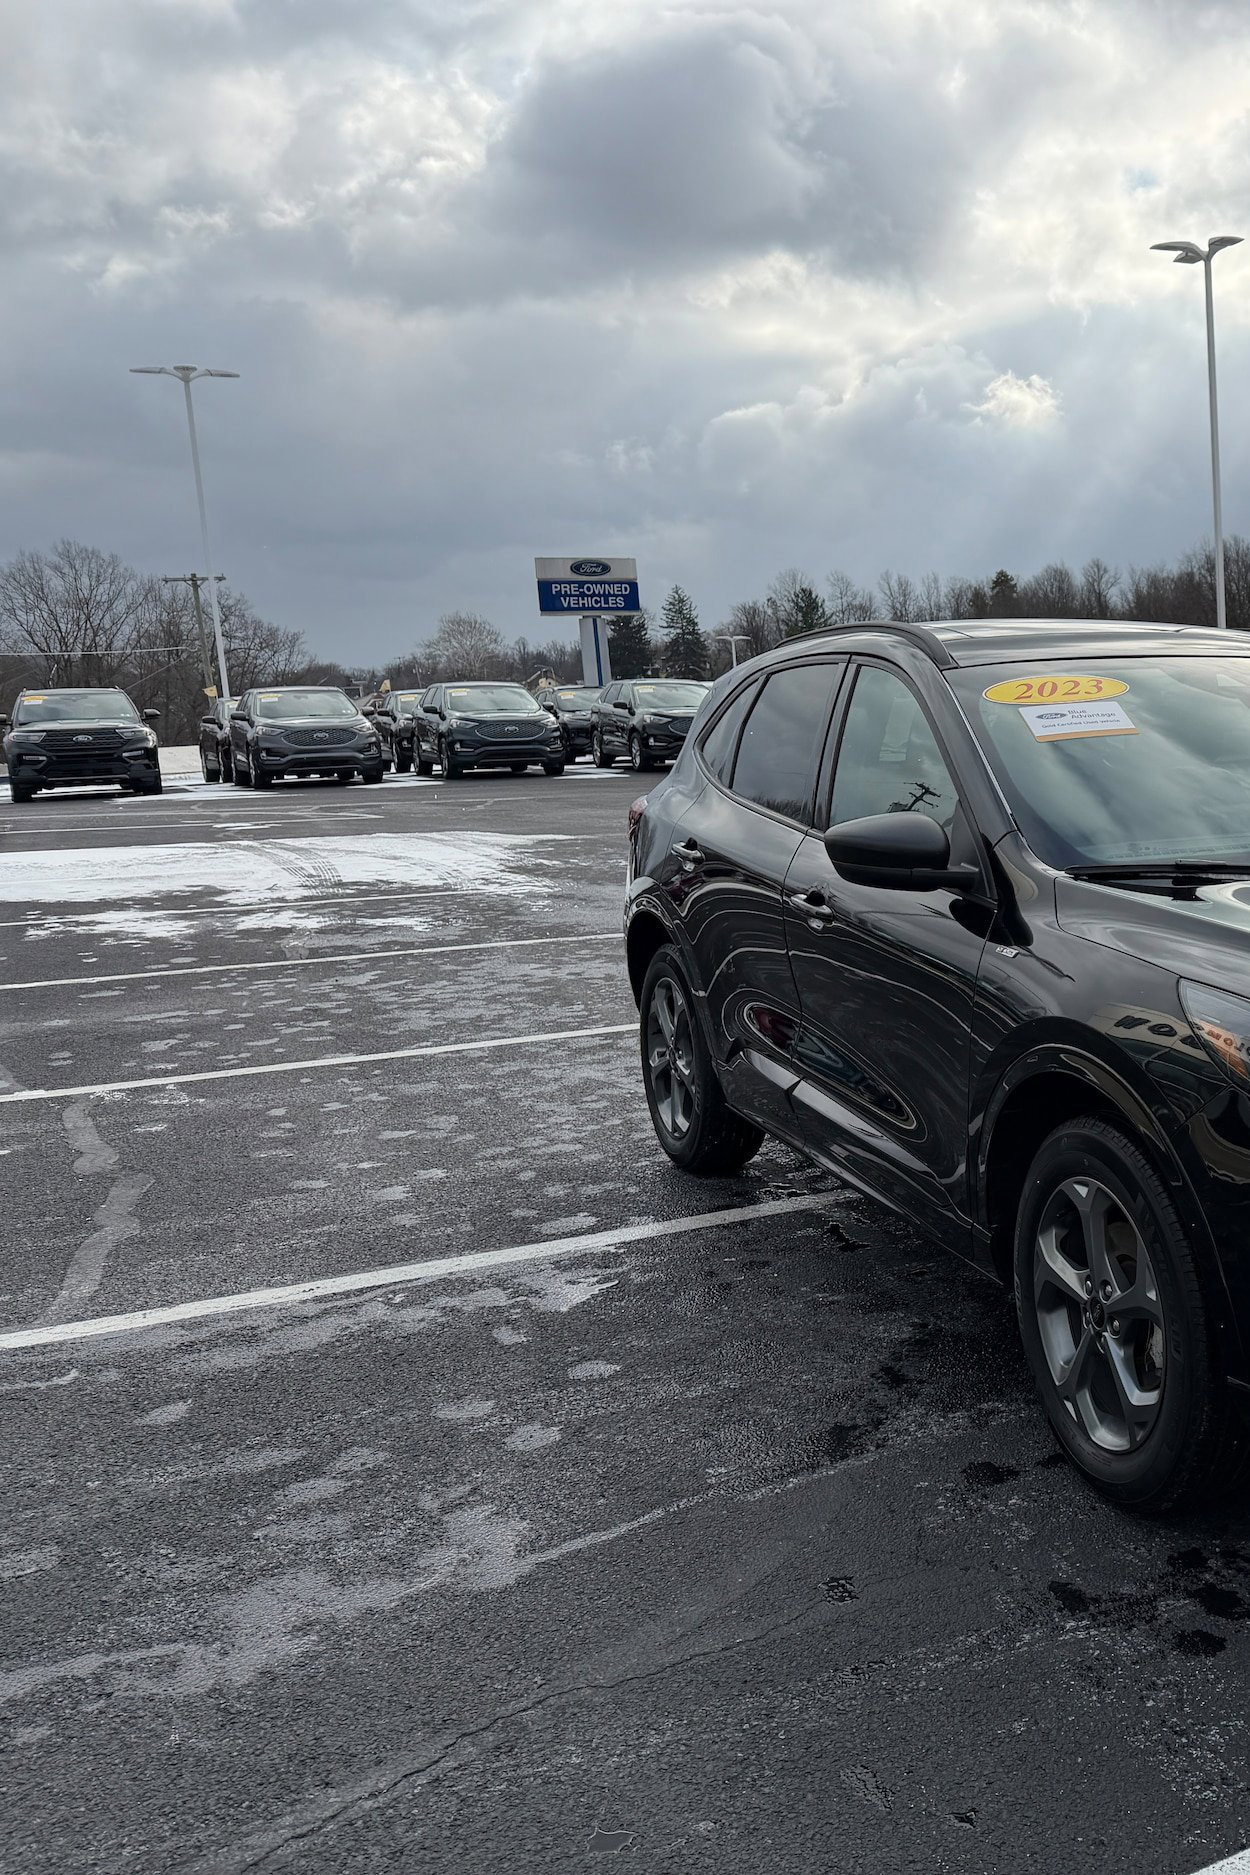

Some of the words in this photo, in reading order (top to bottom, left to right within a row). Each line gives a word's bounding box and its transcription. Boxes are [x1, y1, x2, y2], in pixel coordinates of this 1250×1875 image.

[579, 563, 603, 573] Ford
[551, 583, 631, 595] PRE-OWNED
[560, 597, 625, 608] VEHICLES
[1013, 678, 1105, 701] 2023
